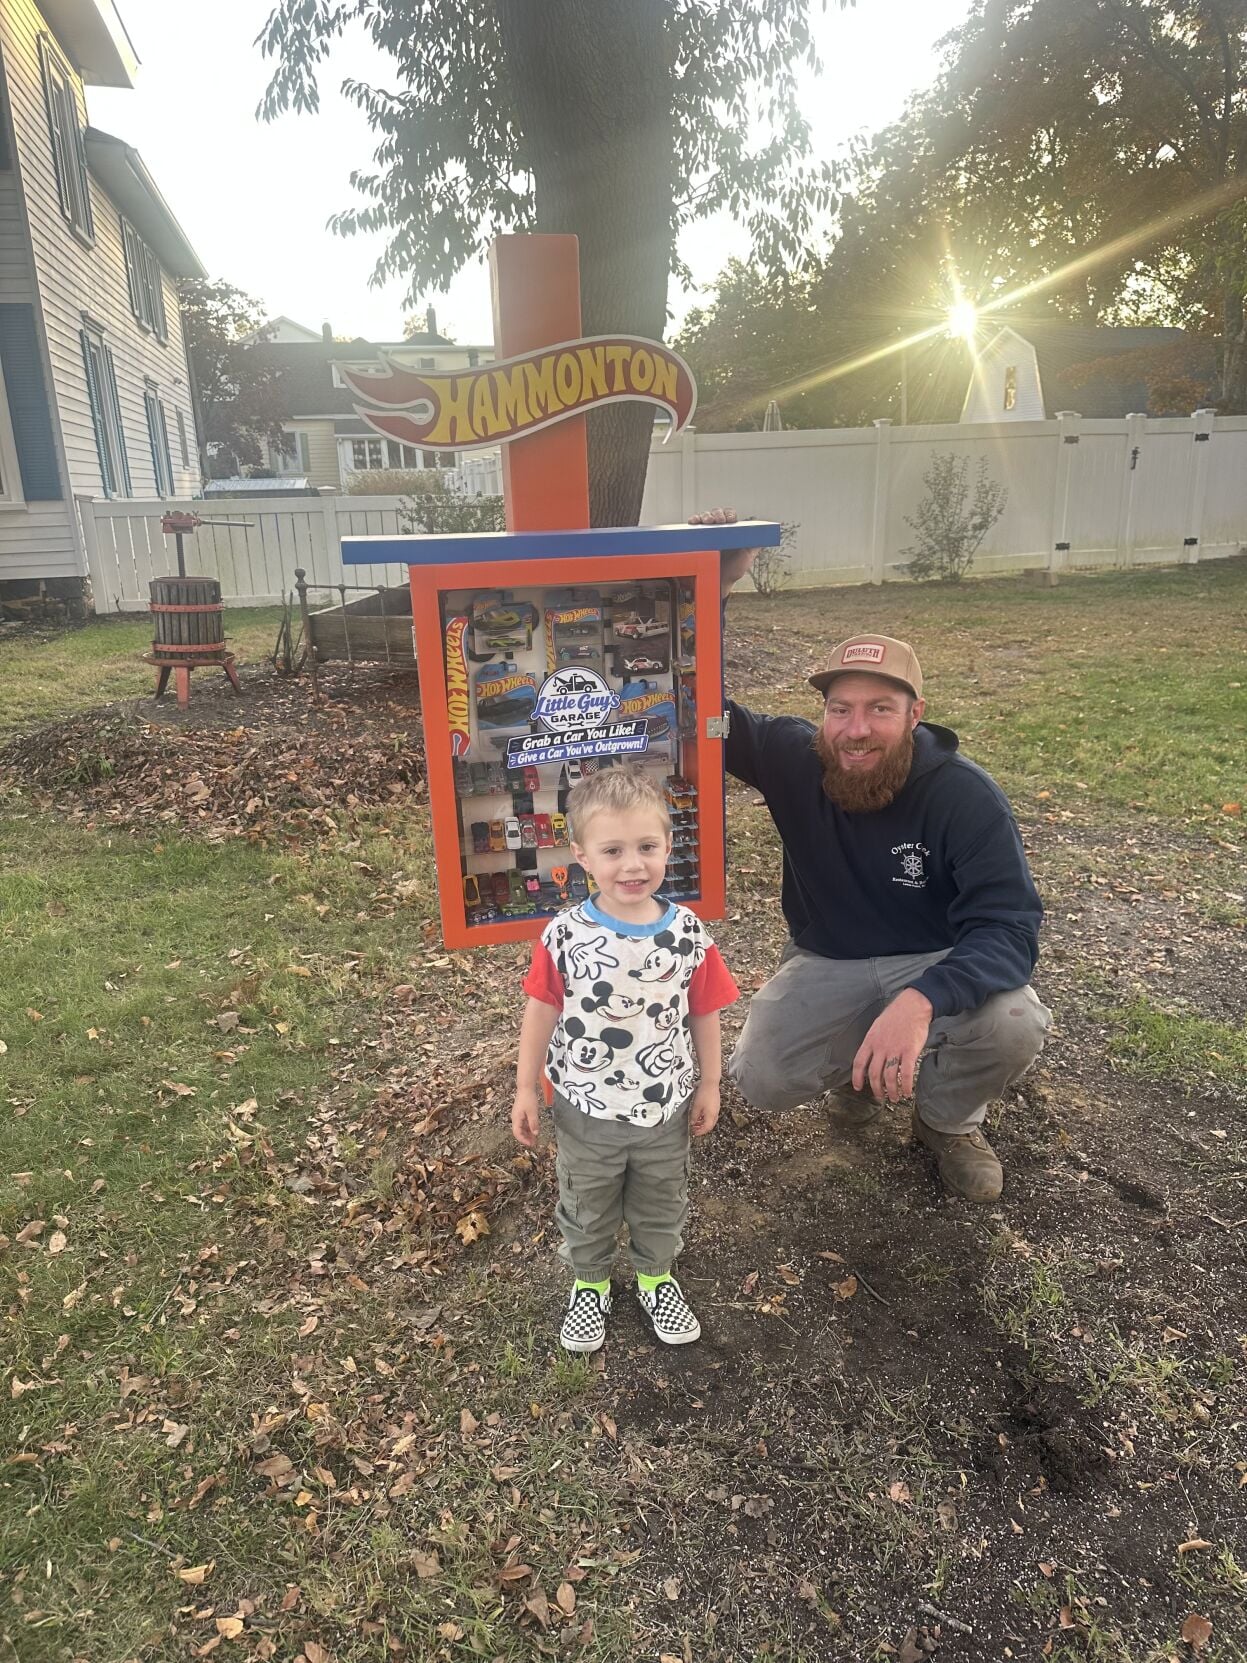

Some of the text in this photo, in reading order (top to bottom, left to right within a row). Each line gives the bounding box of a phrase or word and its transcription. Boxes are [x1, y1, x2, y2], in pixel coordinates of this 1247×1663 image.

[417, 345, 678, 443] HAMMONTON
[846, 647, 880, 659] DULUTH
[531, 692, 619, 718] Little Guy's
[550, 711, 601, 723] GARAGE
[522, 723, 637, 750] Grab a Car You Like!
[517, 739, 643, 764] Give a Car You've Outgrown!
[891, 842, 915, 854] Oyster
